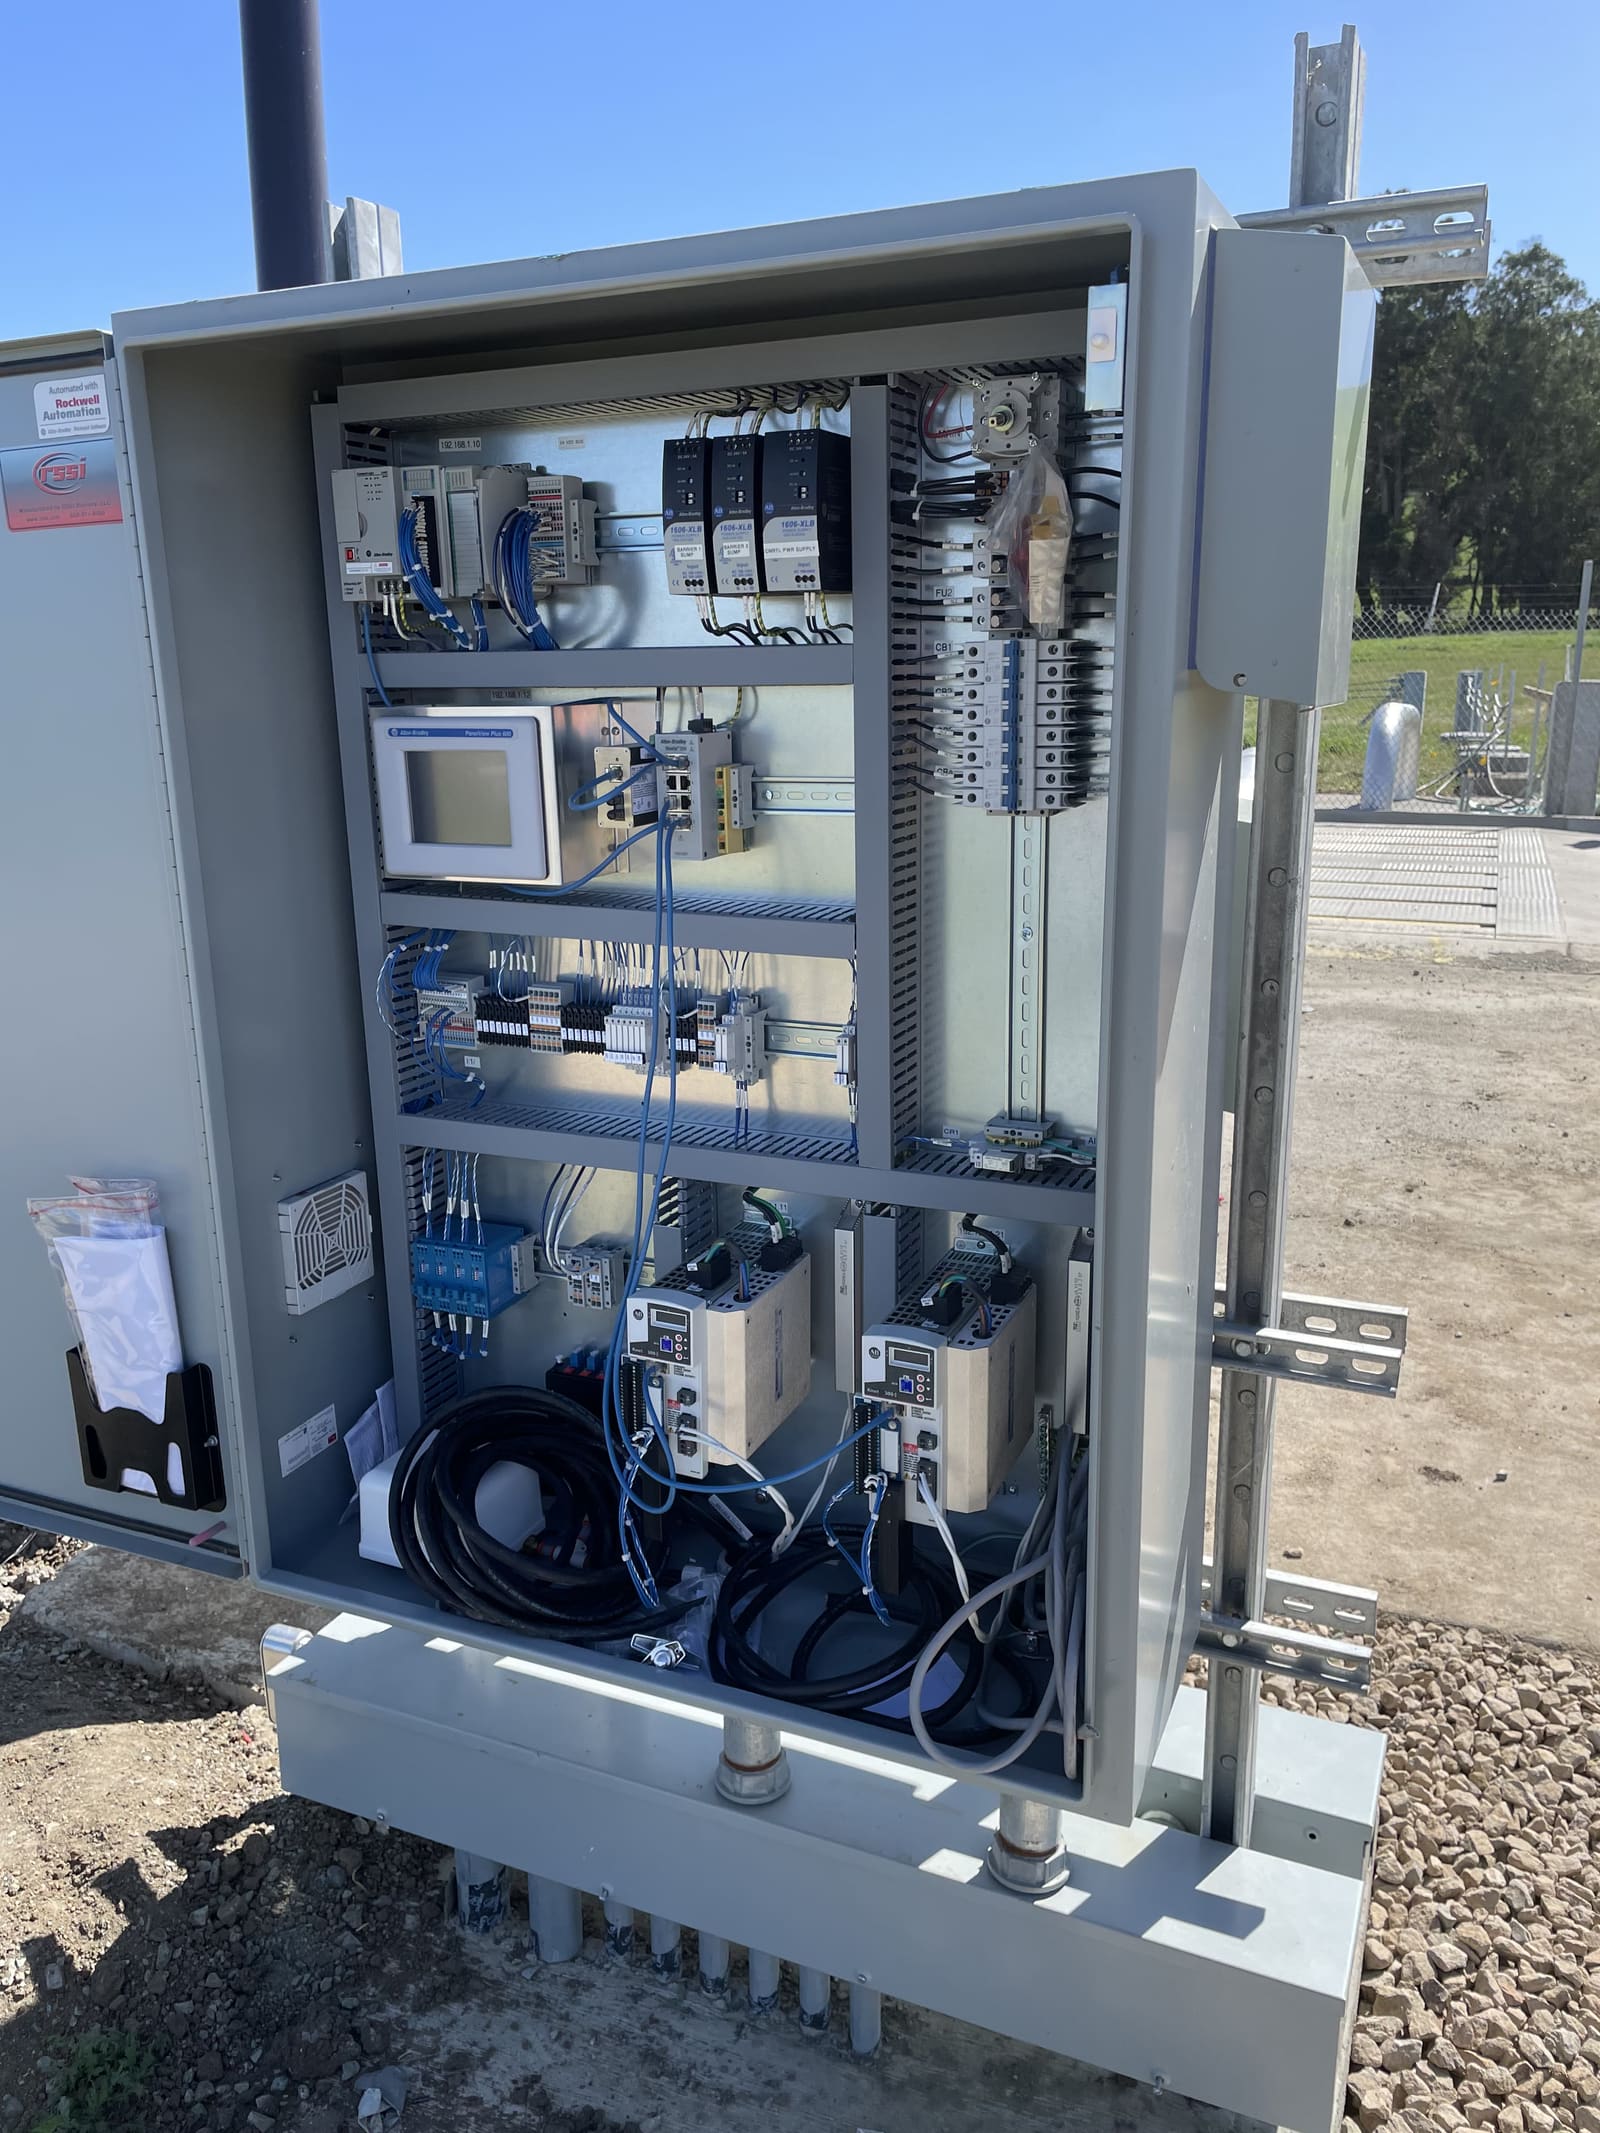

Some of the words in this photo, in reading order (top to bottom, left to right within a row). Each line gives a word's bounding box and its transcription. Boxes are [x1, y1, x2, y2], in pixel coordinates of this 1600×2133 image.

[49, 382, 84, 394] Automated
[84, 382, 98, 392] with
[56, 394, 100, 408] Rockwell
[43, 406, 101, 422] Automation
[440, 440, 480, 448] 192.168.1.10
[40, 456, 86, 483] rssi
[720, 523, 752, 532] 1606-XLB
[782, 520, 815, 529] 1606-XLB
[671, 526, 702, 534] 1606-XLB
[936, 588, 952, 598] FU2
[936, 642, 952, 652] CB1
